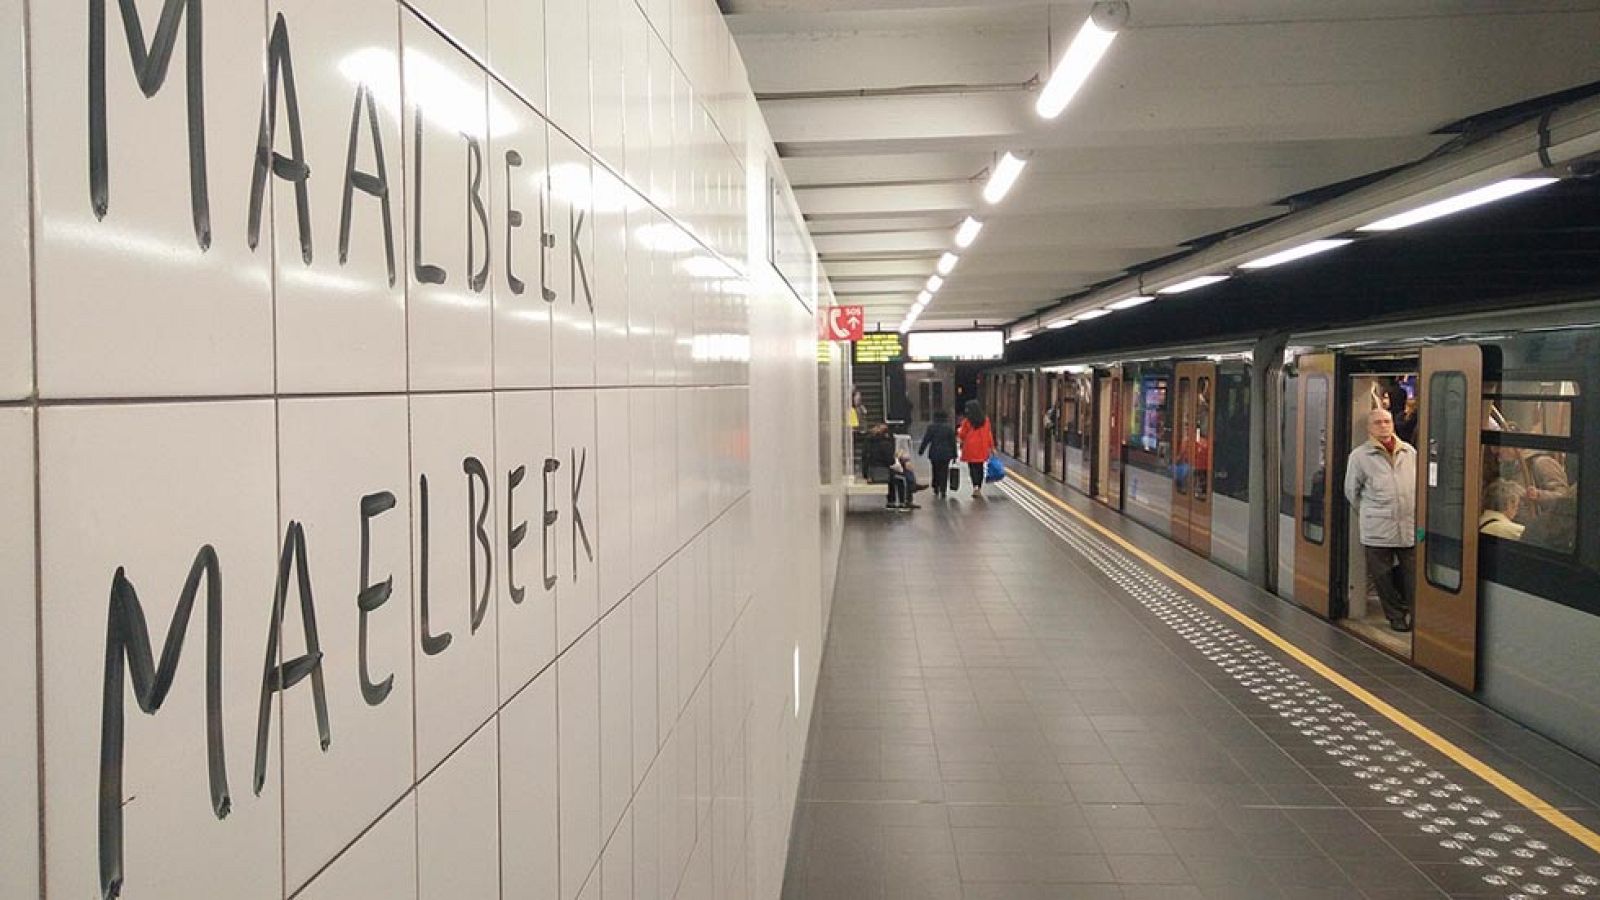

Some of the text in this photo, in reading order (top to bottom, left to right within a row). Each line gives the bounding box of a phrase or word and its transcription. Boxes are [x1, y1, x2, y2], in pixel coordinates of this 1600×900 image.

[88, 0, 594, 313] MAALBEEK
[844, 307, 861, 316] SOS
[98, 447, 593, 900] MAELBEEK
